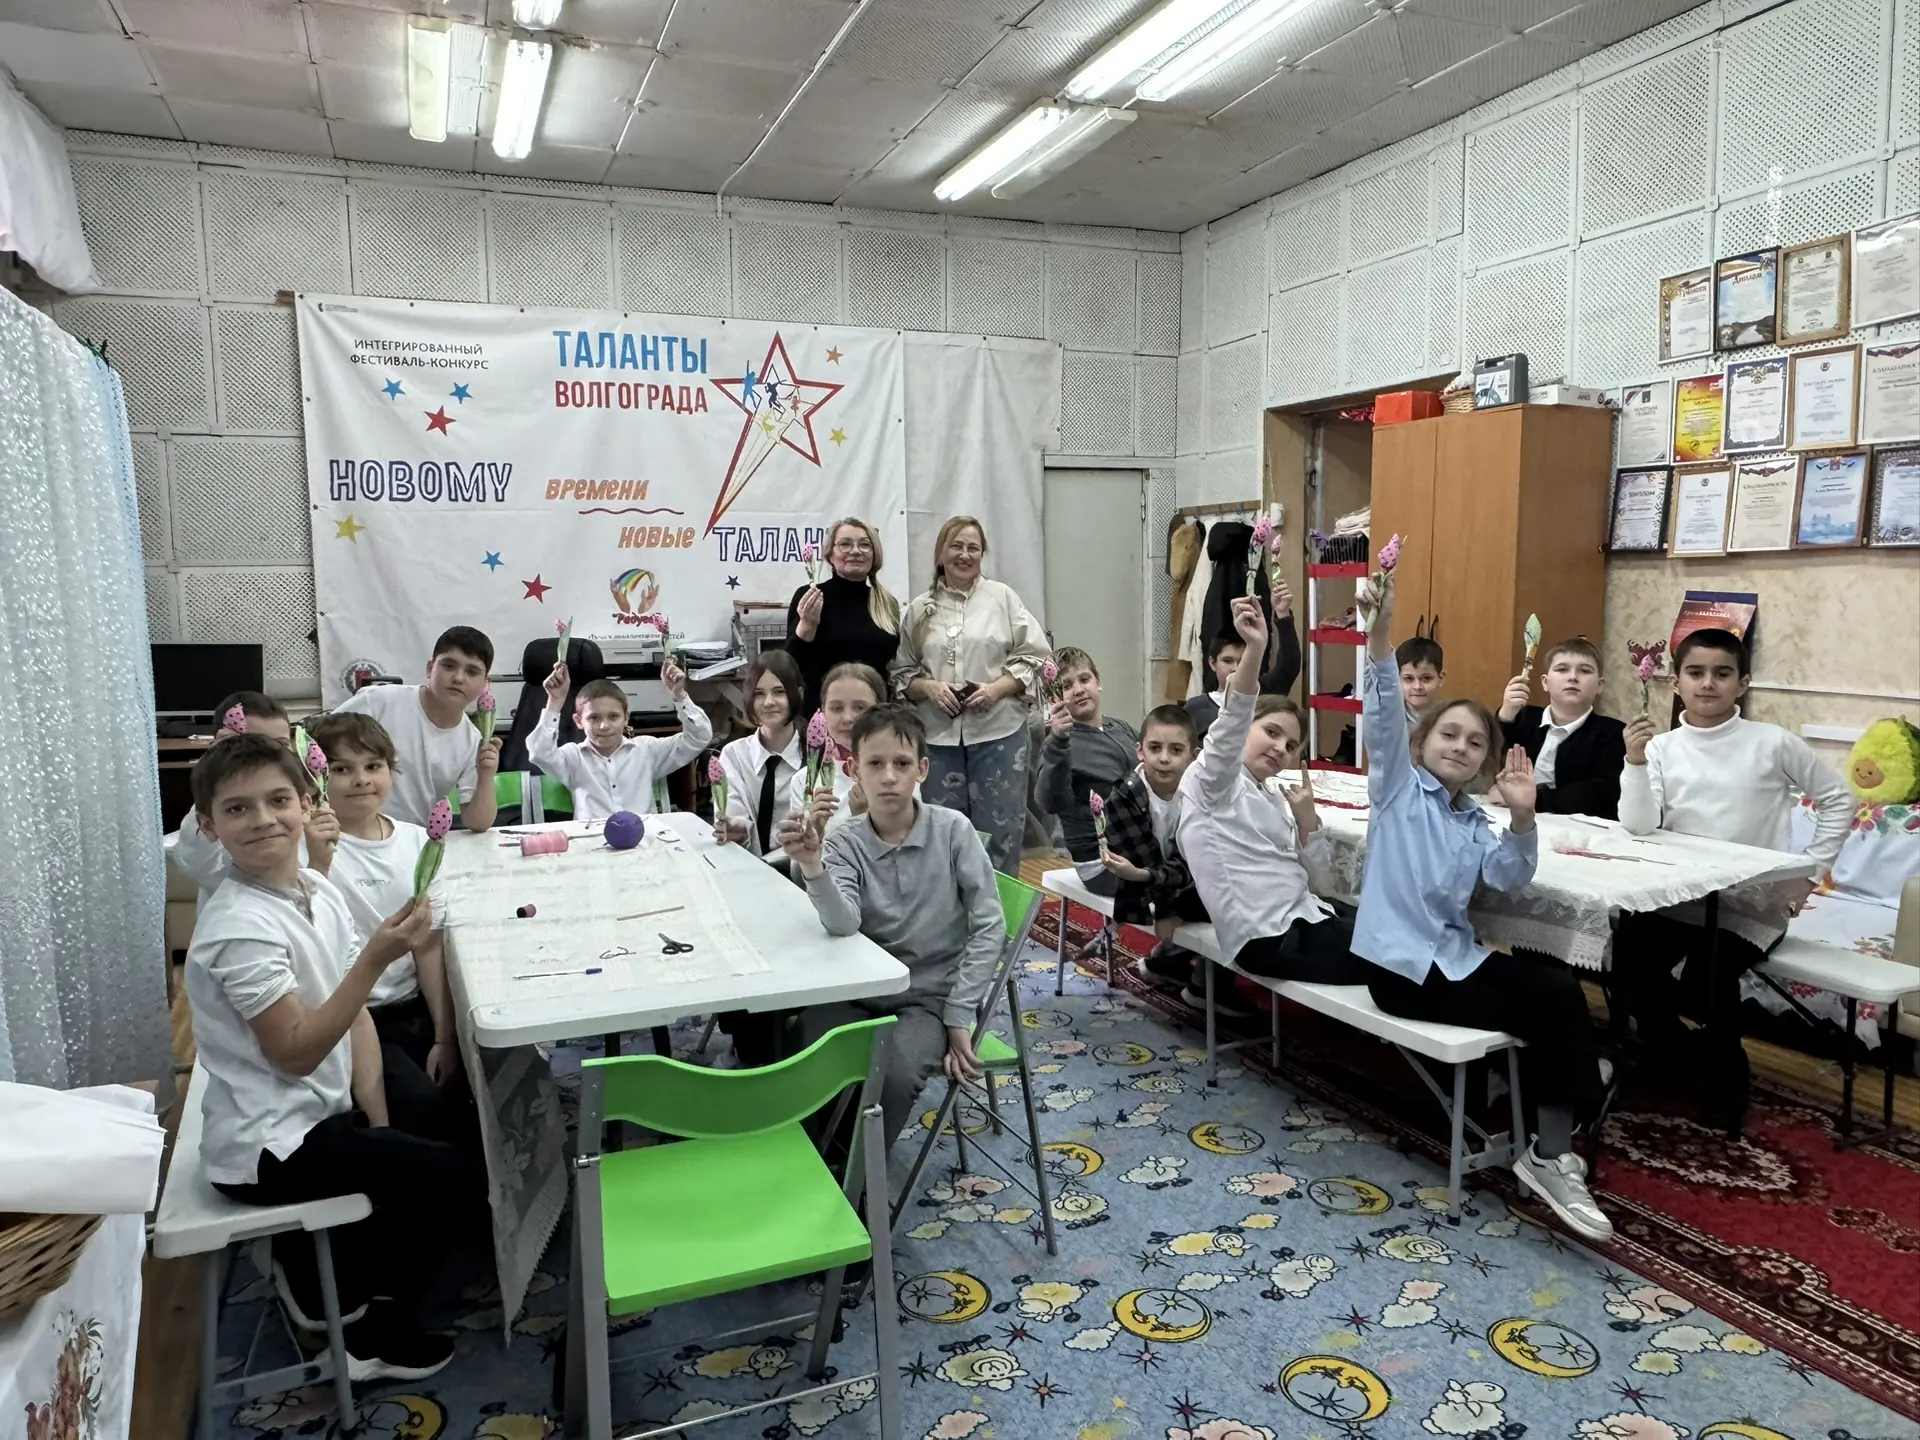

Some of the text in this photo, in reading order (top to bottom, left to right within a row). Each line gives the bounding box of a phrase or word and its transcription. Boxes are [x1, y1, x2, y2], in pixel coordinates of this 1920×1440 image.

[350, 353, 489, 370] ФЕСТИВАЛЬ-КОНКУРС
[354, 339, 483, 355] ИНТЕГРИРОВАННЫЙ
[553, 330, 707, 374] ТАЛАНТЫ
[555, 380, 708, 415] ВОЛГОГРАДА
[329, 459, 513, 502] НОВОМУ
[712, 526, 880, 562] ТАЛАН
